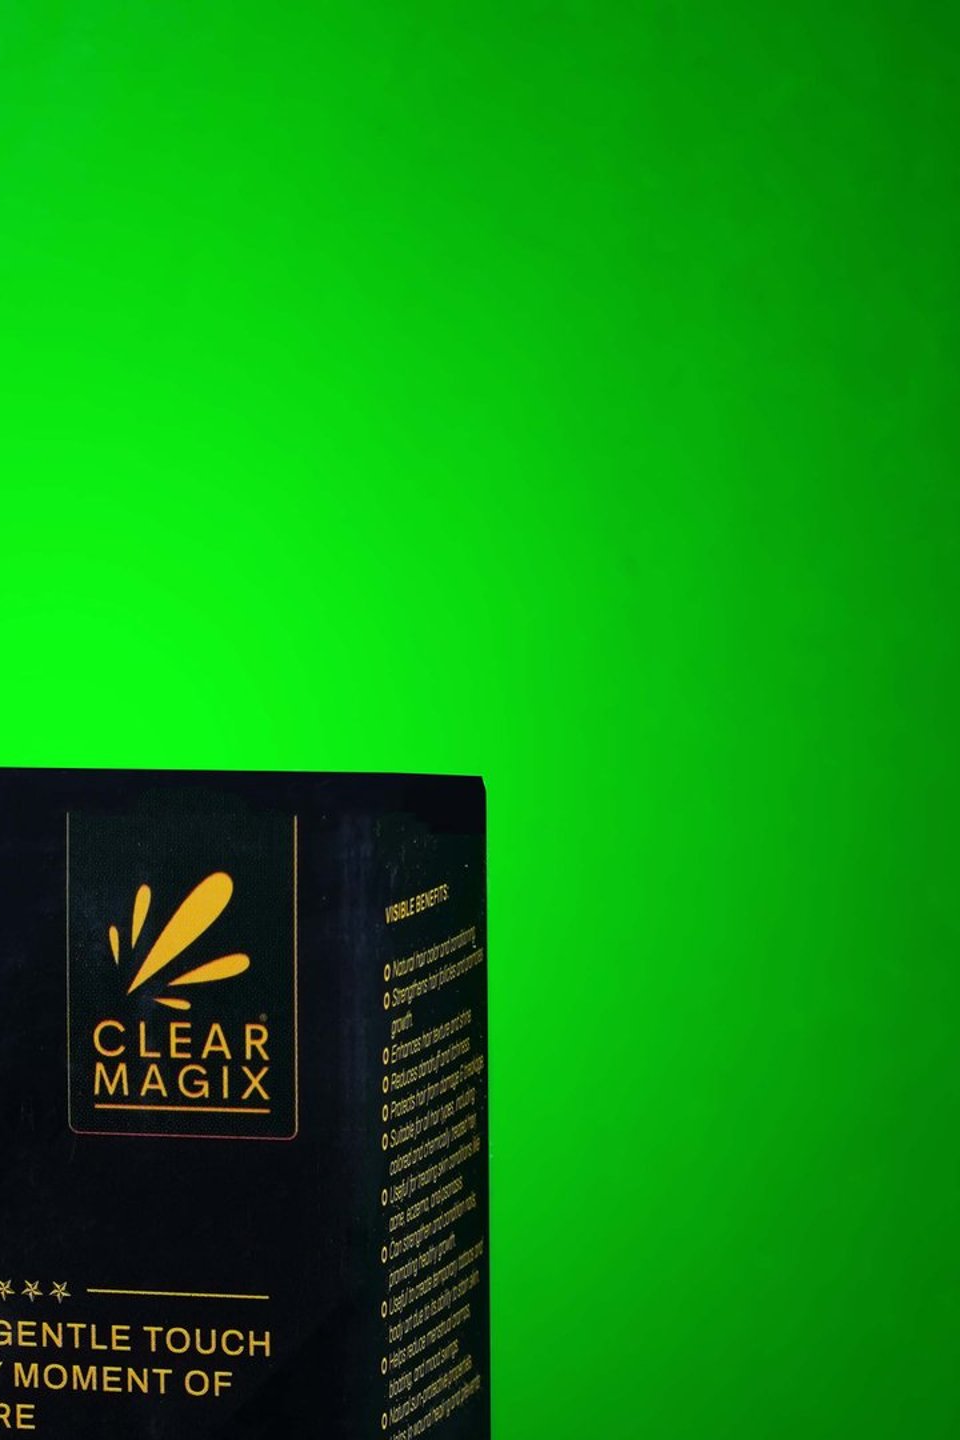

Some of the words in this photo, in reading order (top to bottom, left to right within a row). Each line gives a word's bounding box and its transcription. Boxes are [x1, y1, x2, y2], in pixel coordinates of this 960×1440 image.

[385, 897, 414, 923] VISIBLE
[92, 1019, 270, 1061] CLEAR
[93, 1061, 270, 1100] MAGIX
[143, 1326, 271, 1357] TOUCH
[14, 1363, 173, 1395] MOMENT
[184, 1371, 233, 1397] OF
